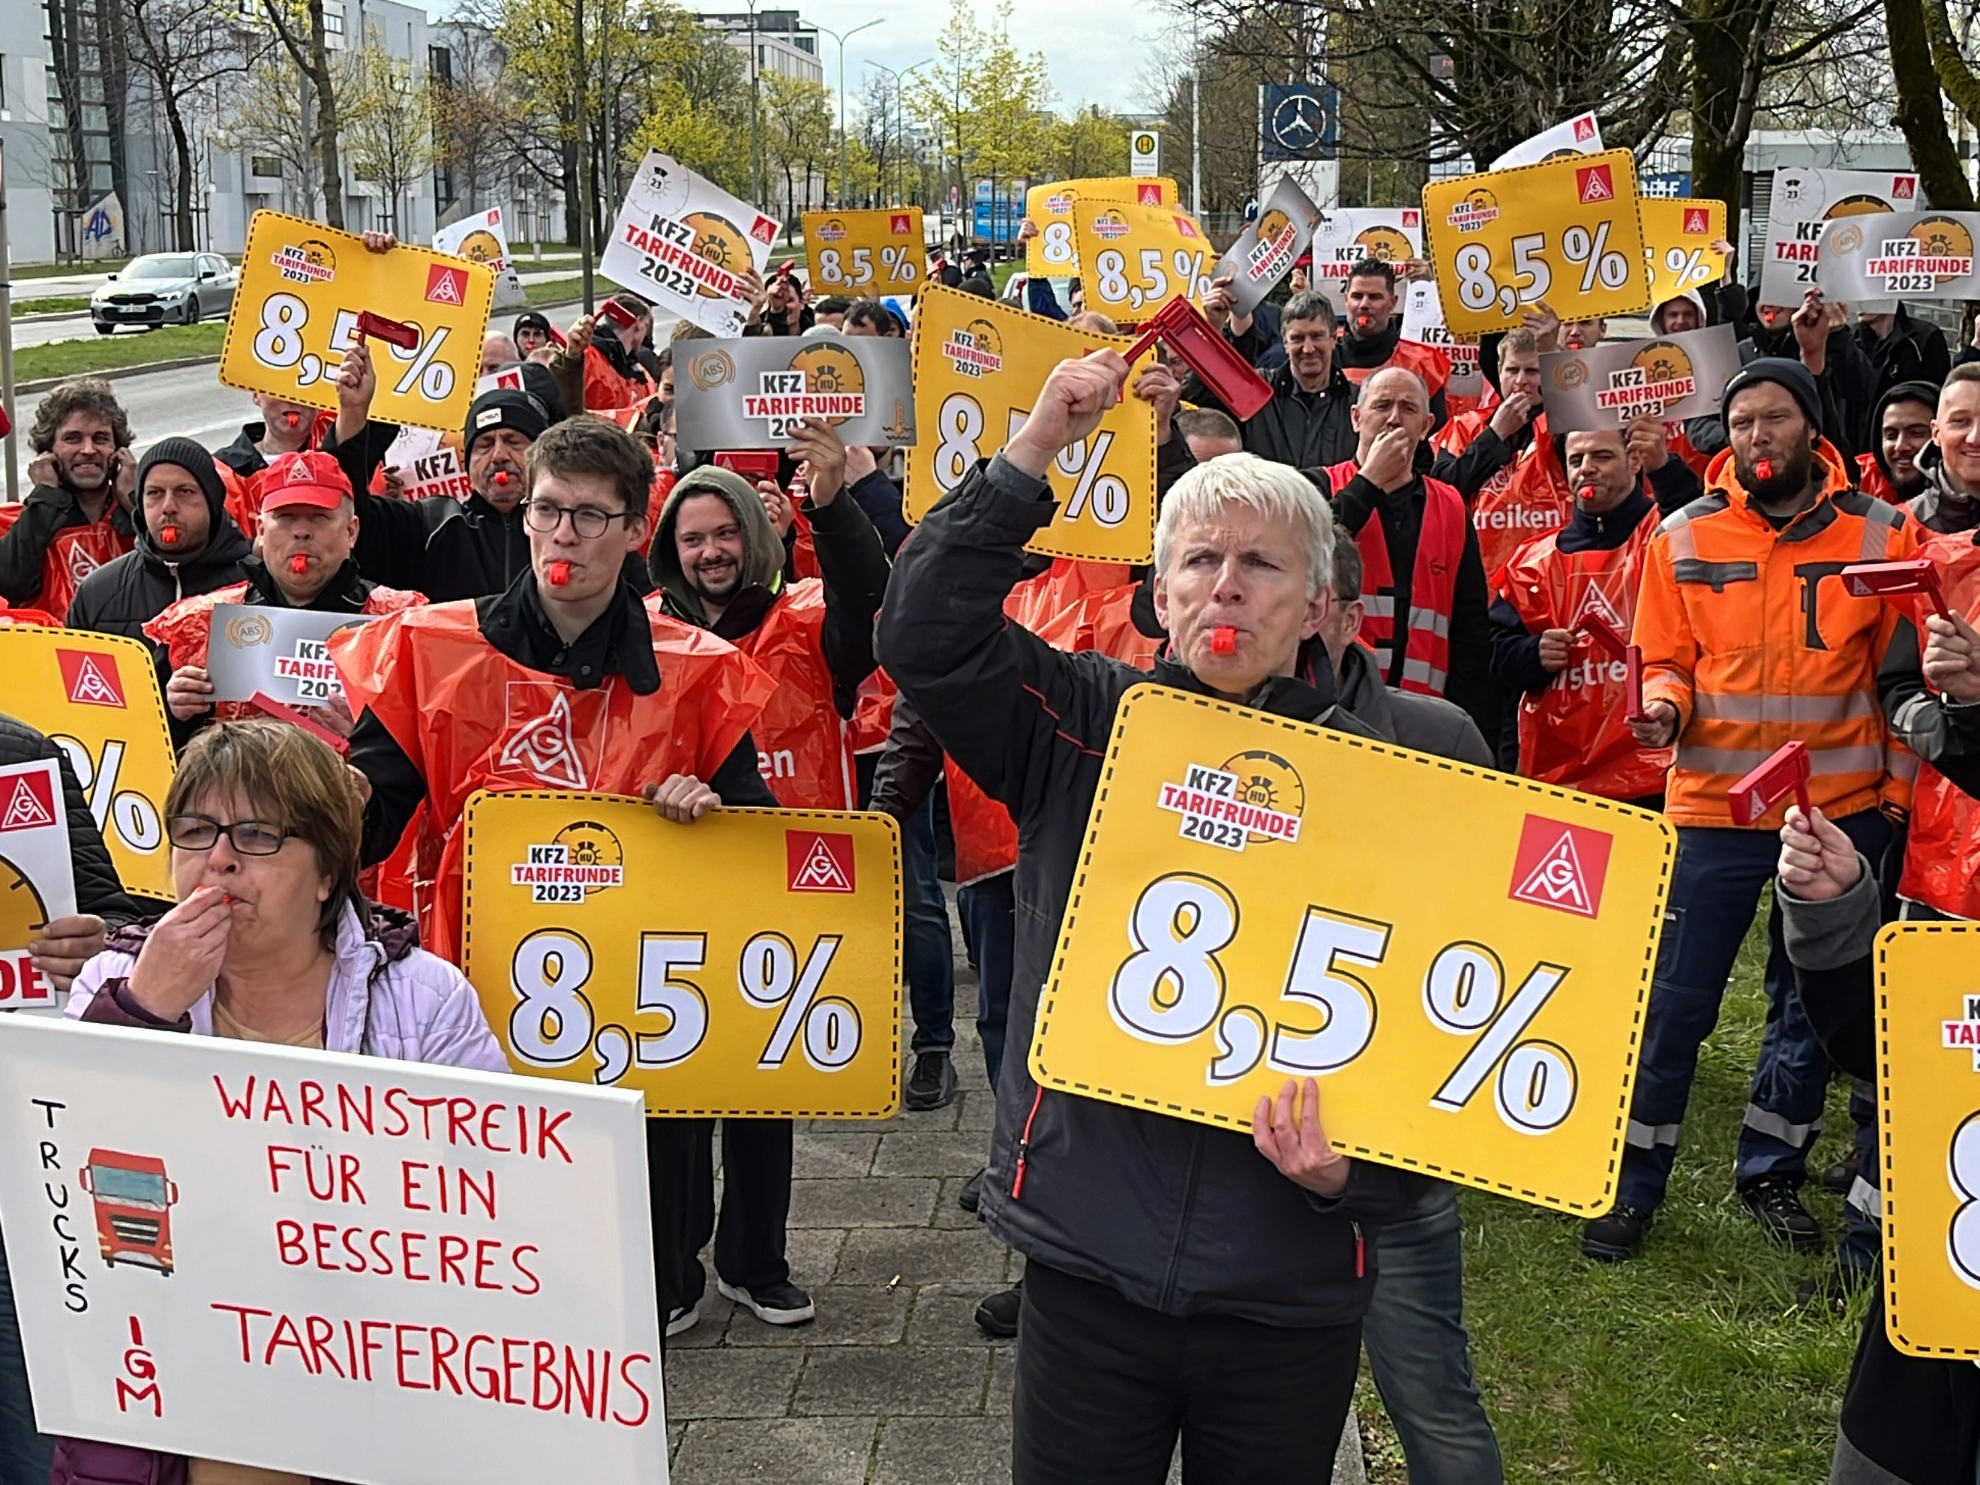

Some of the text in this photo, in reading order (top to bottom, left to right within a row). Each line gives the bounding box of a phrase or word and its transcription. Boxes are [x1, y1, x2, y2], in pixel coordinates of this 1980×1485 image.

[650, 178, 663, 190] 23
[1787, 190, 1799, 199] 23
[650, 214, 691, 247] KFZ
[1459, 221, 1481, 232] 2023
[1797, 222, 1823, 241] KF
[284, 246, 304, 261] KFZ
[1249, 222, 1297, 279] TARIFRUNDE
[1250, 241, 1270, 263] KFZ
[1336, 247, 1365, 261] KFZ
[1884, 241, 1917, 257] KFZ
[273, 254, 333, 280] TARIFRUNDE
[283, 268, 309, 283] 2023
[819, 244, 918, 290] 8,5 %
[1266, 251, 1291, 279] 2023
[1454, 232, 1552, 317] 8,5
[1562, 220, 1629, 293] %
[1868, 259, 1971, 275] TARIFRUNDE
[639, 257, 695, 297] 2023
[1096, 248, 1212, 310] 8,5 %
[1887, 275, 1932, 291] 2023
[954, 331, 973, 348] KFZ
[1421, 327, 1451, 344] KFZ
[944, 343, 1001, 369] TARIFRUNDE
[702, 362, 724, 377] ABS
[955, 359, 980, 377] 2023
[763, 375, 802, 394] KFZ
[1612, 370, 1643, 389] KFZ
[1598, 379, 1694, 407] TARIFRUNDE
[745, 396, 863, 416] TARIFRUNDE
[414, 451, 456, 482] KFZ
[1054, 430, 1130, 525] %
[239, 625, 261, 638] ABS
[1188, 768, 1233, 797] KFZ
[1249, 790, 1267, 804] HU
[1164, 785, 1298, 839] TARIFRUNDE
[1183, 816, 1244, 848] 2023
[531, 847, 565, 864] KFZ
[513, 866, 621, 884] TARIFRUNDE
[535, 884, 582, 902] 2023
[508, 926, 863, 1085] 8,5 %
[1108, 870, 1580, 1136] 8,5 %
[213, 1075, 575, 1164] WARNSTREIK
[267, 1144, 498, 1220] FÜR EIN
[277, 1220, 542, 1296] BESSERES
[211, 1302, 652, 1428] TARIFERGEBNIS
